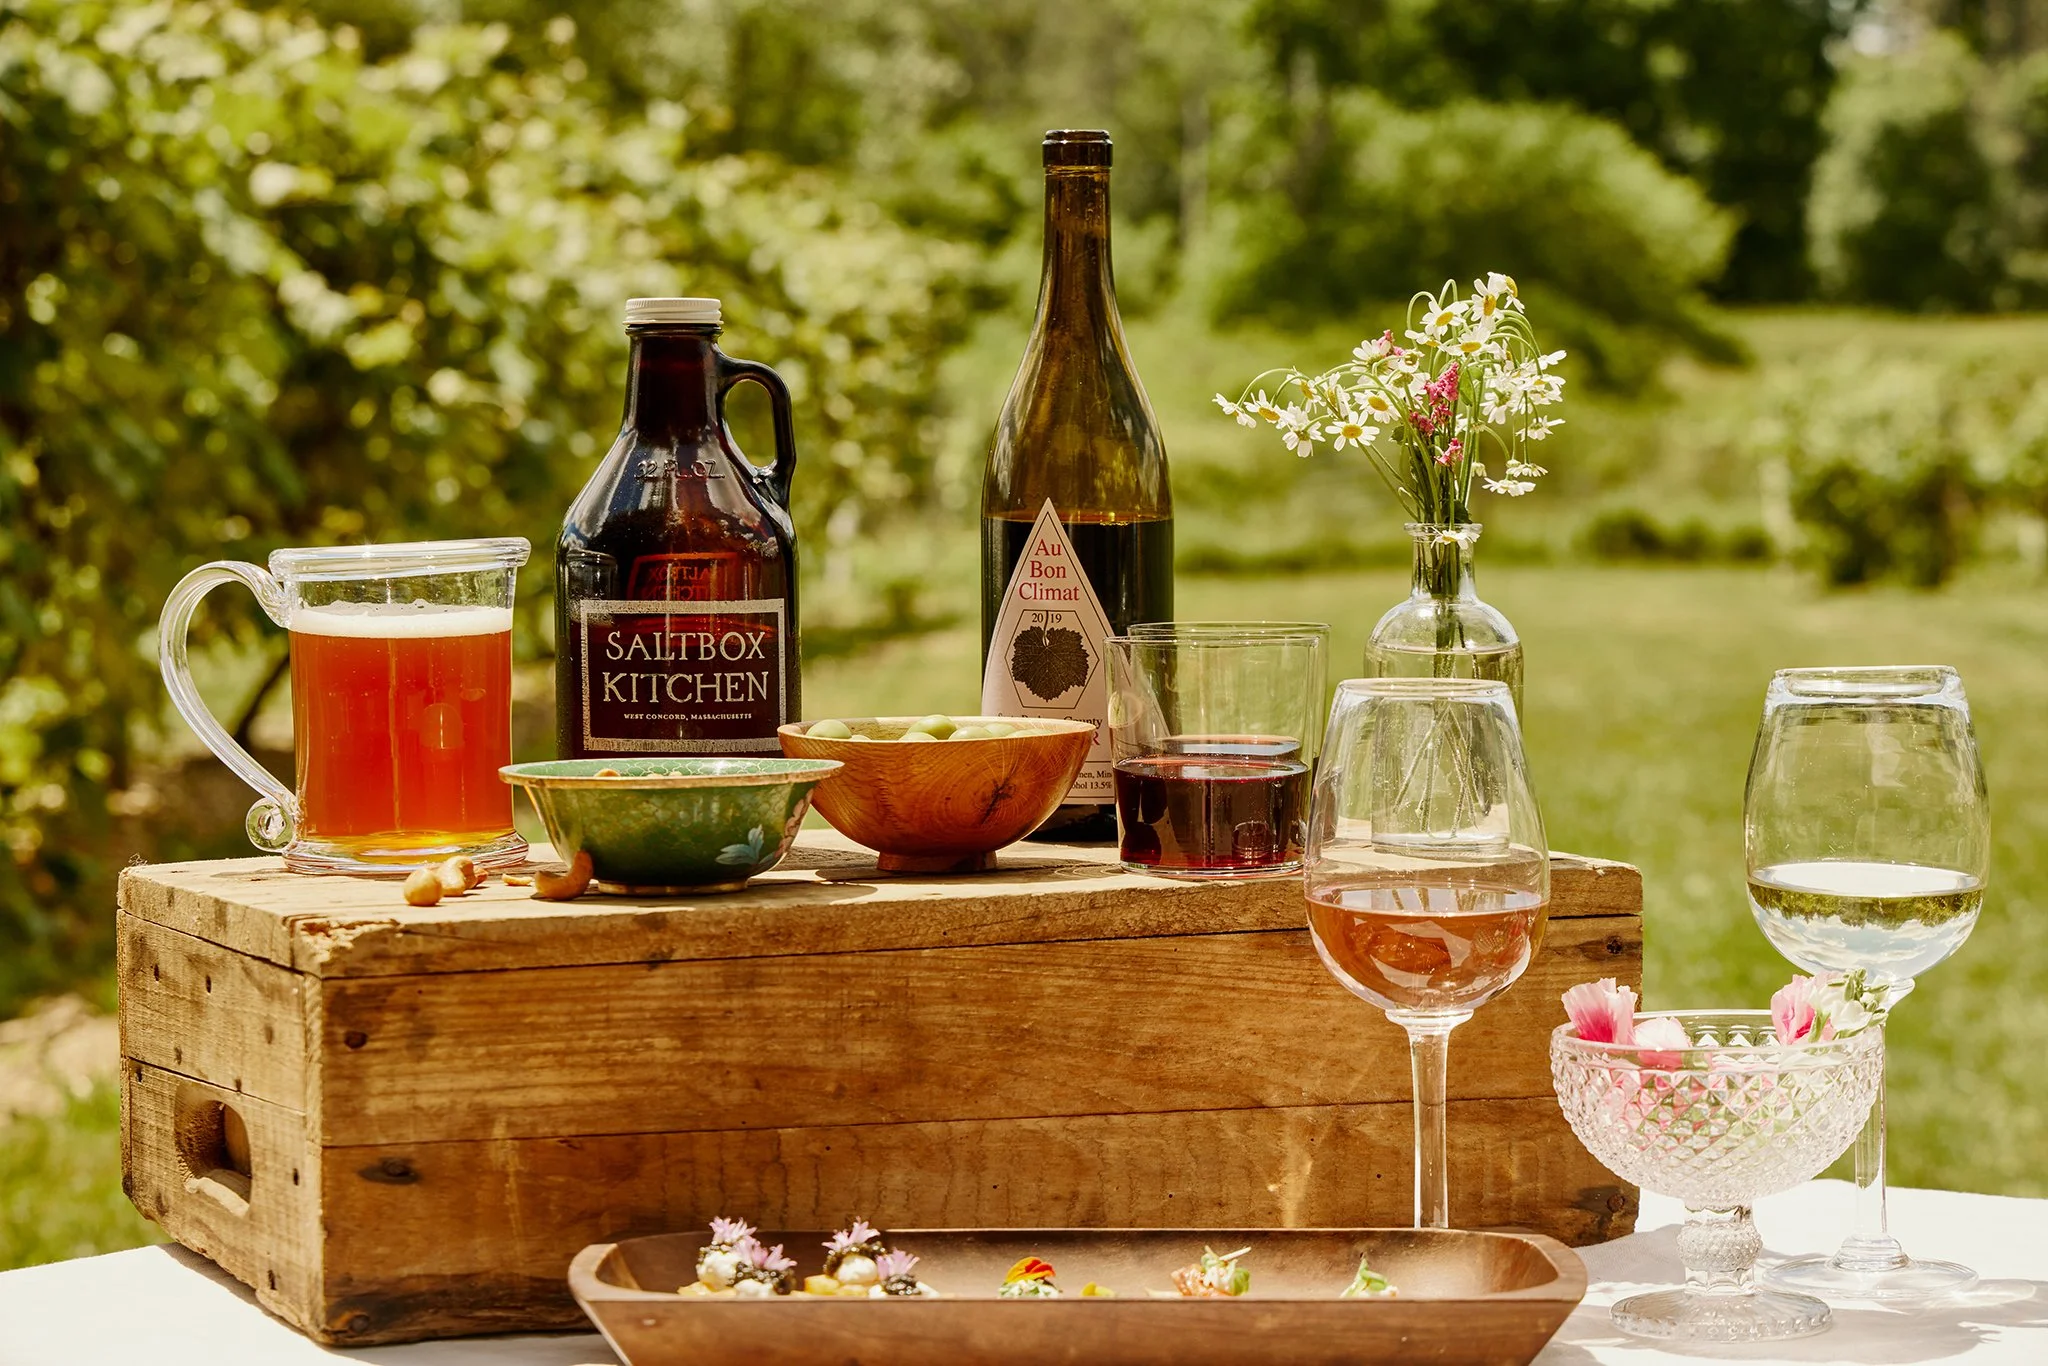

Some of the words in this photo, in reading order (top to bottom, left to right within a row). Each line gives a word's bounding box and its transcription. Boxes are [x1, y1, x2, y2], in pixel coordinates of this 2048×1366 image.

[634, 460, 659, 479] 32
[1034, 538, 1062, 556] Au
[1029, 560, 1067, 579] Bon
[1018, 582, 1080, 601] Climat
[606, 630, 766, 661] SALTBOX
[602, 671, 769, 703] KITCHEN
[623, 713, 645, 721] WEST
[645, 713, 689, 721] CONCORD,
[690, 712, 752, 721] MASSACHUSETTS
[1089, 781, 1113, 790] 13.5%
